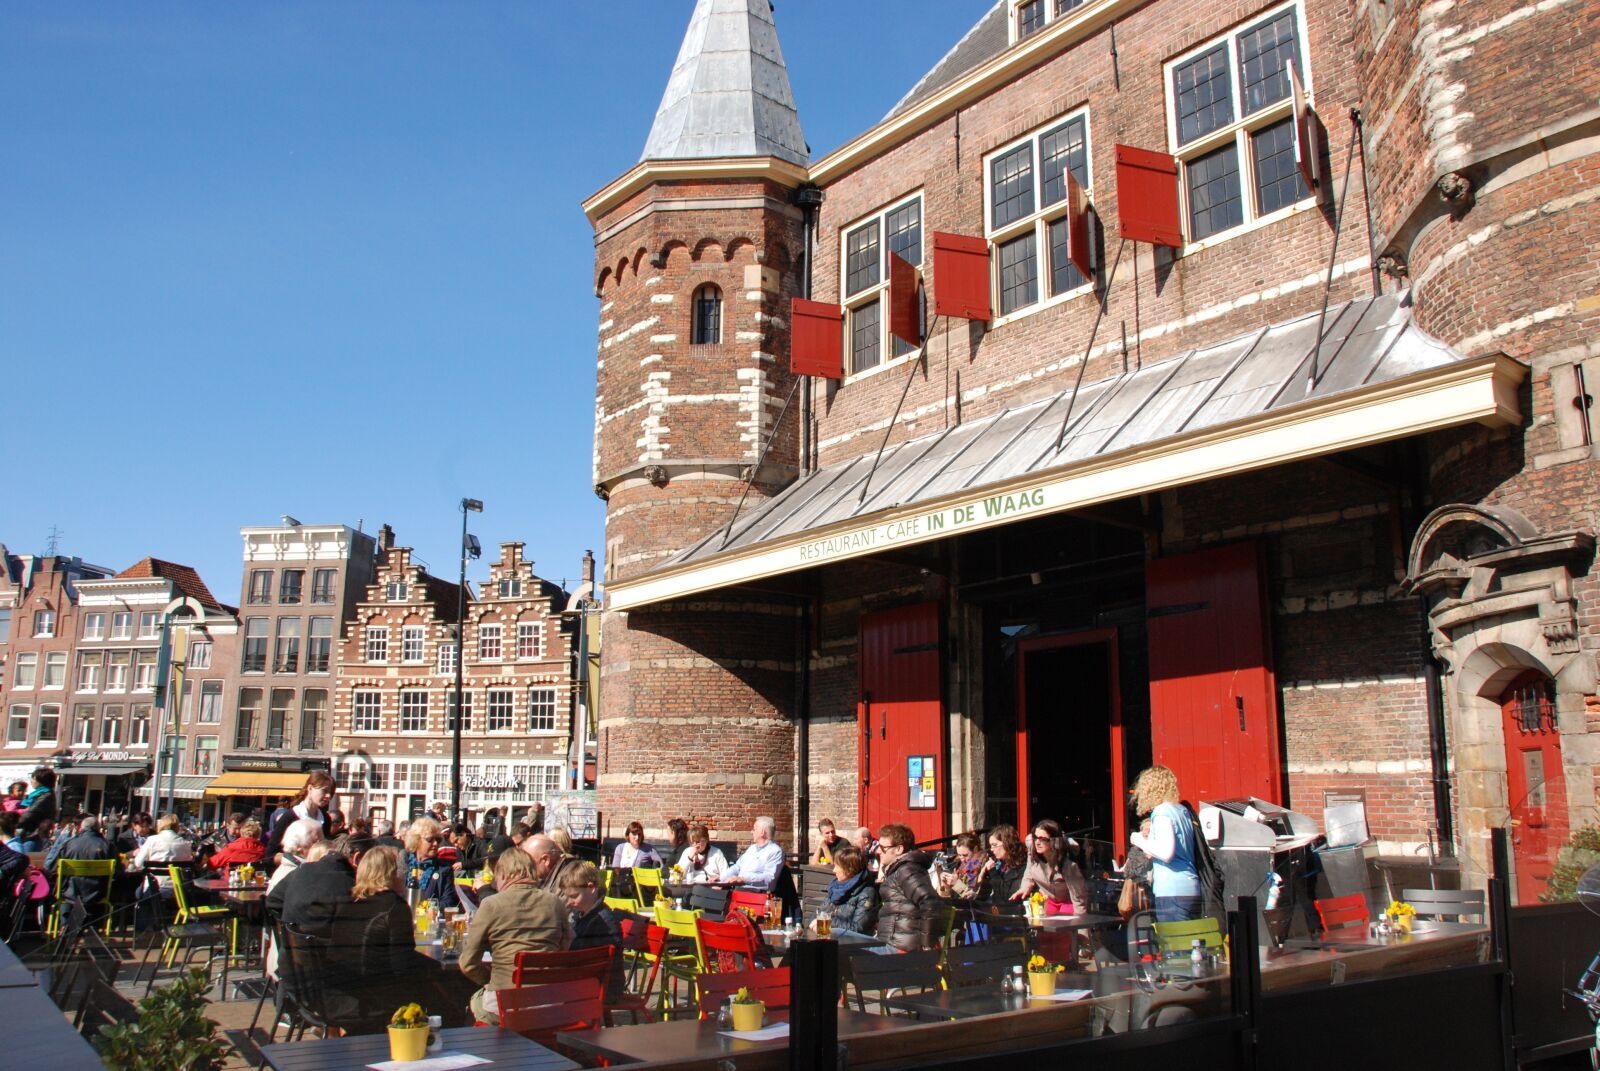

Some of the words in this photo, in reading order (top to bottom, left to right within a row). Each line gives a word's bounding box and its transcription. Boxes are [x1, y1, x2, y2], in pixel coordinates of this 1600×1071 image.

[927, 512, 944, 531] IN
[953, 505, 975, 524] DE
[984, 488, 1044, 517] WAAG
[102, 751, 129, 760] MONDO
[463, 775, 519, 788] Rabobank
